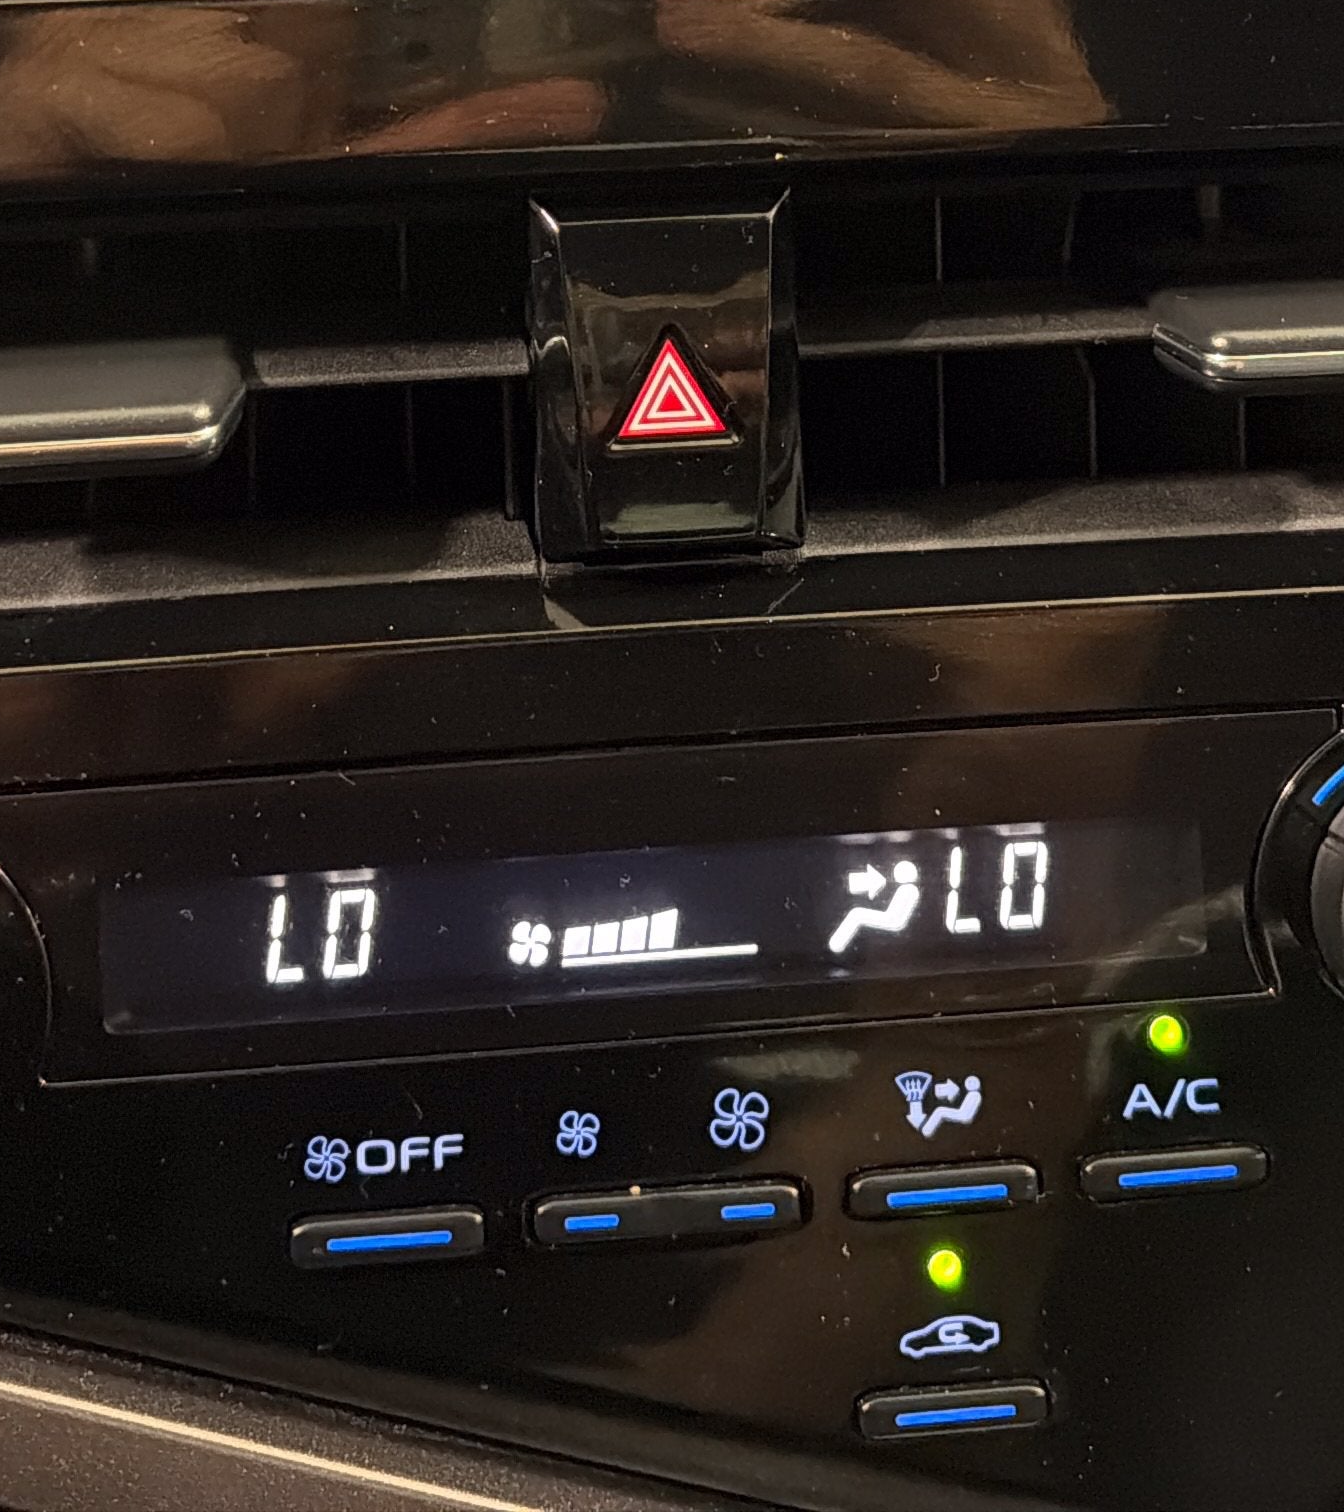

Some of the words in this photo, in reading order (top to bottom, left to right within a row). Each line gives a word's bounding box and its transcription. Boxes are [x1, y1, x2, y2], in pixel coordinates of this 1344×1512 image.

[945, 840, 1049, 934] LO
[265, 887, 378, 984] LO
[1122, 1078, 1220, 1119] A/C
[356, 1133, 464, 1175] OFF
